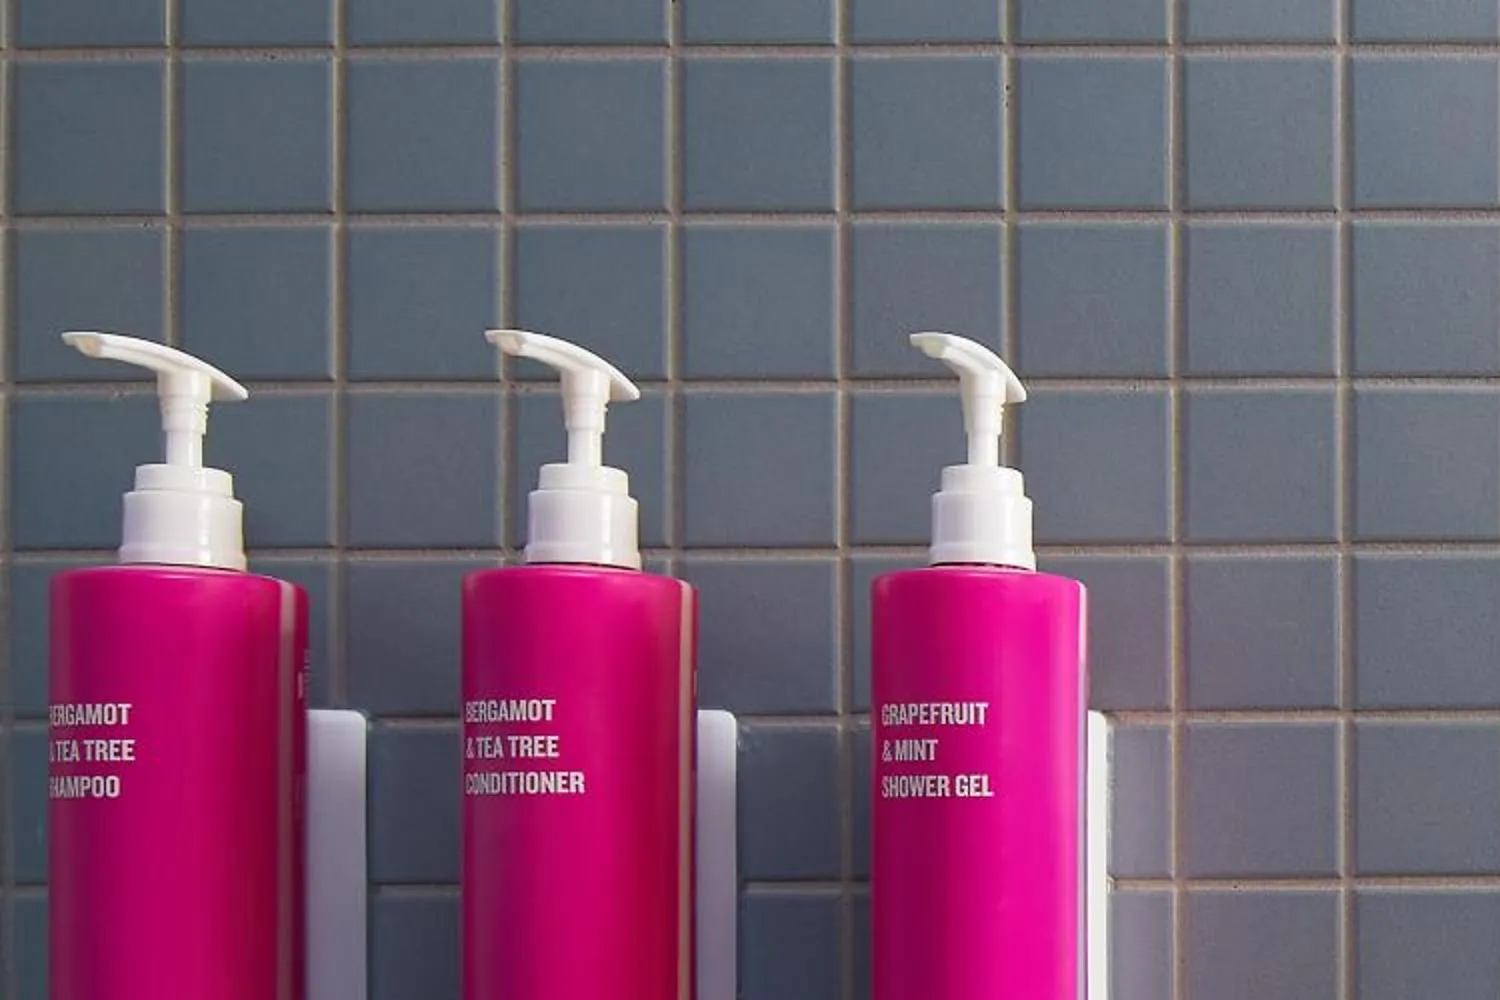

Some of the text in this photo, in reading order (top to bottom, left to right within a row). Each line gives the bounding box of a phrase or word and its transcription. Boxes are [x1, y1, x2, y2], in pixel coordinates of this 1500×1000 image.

[465, 699, 557, 723] BERGAMOT
[881, 702, 989, 726] GRAPEFRUIT
[56, 739, 81, 762] TEA
[84, 739, 135, 761] TREE
[466, 736, 560, 759] & TEA TREE
[882, 739, 939, 762] & MINT
[465, 771, 585, 795] CONDITIONER
[881, 774, 995, 798] SHOWER GEL
